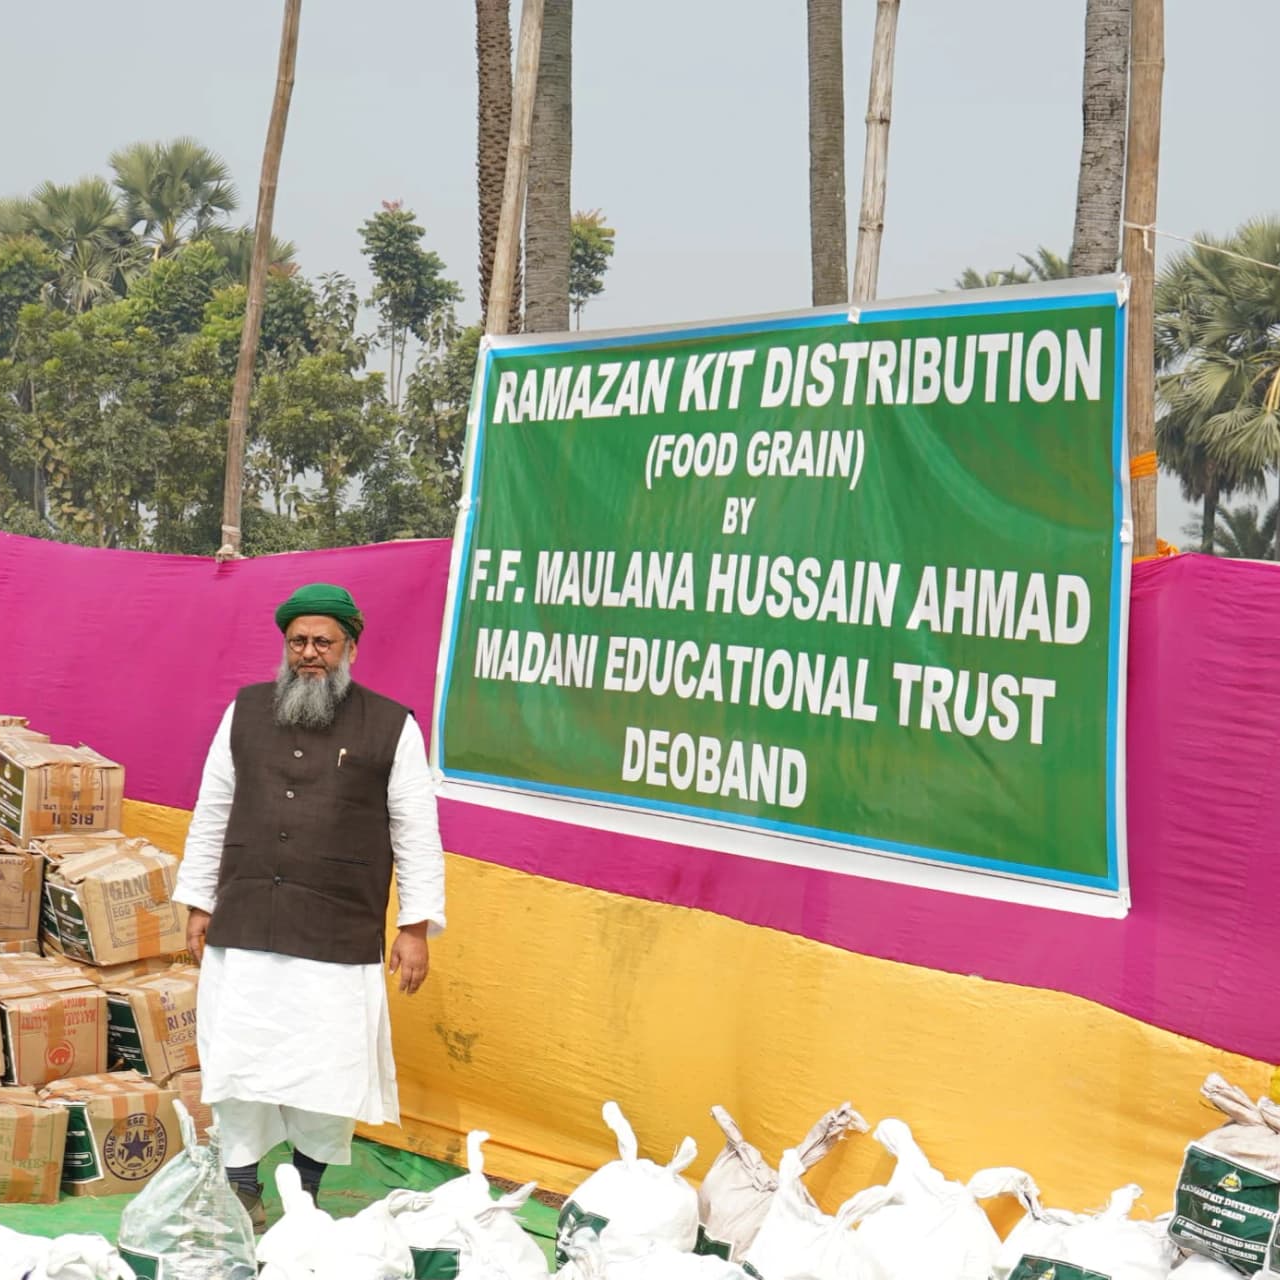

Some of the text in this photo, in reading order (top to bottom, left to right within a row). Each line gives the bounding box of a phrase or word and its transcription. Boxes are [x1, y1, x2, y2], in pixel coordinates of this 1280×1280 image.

[493, 328, 1102, 425] RAMAZAN KIT DISTRIBUTION
[645, 429, 865, 490] (FOOD GRAIN)
[722, 498, 755, 534] BY
[470, 550, 1091, 645] F.F. MAULANA HUSSAIN AHMAD
[474, 628, 1056, 745] MADANI EDUCATIONAL TRUST
[621, 727, 808, 808] DEOBAND
[1211, 1219, 1223, 1228] BY
